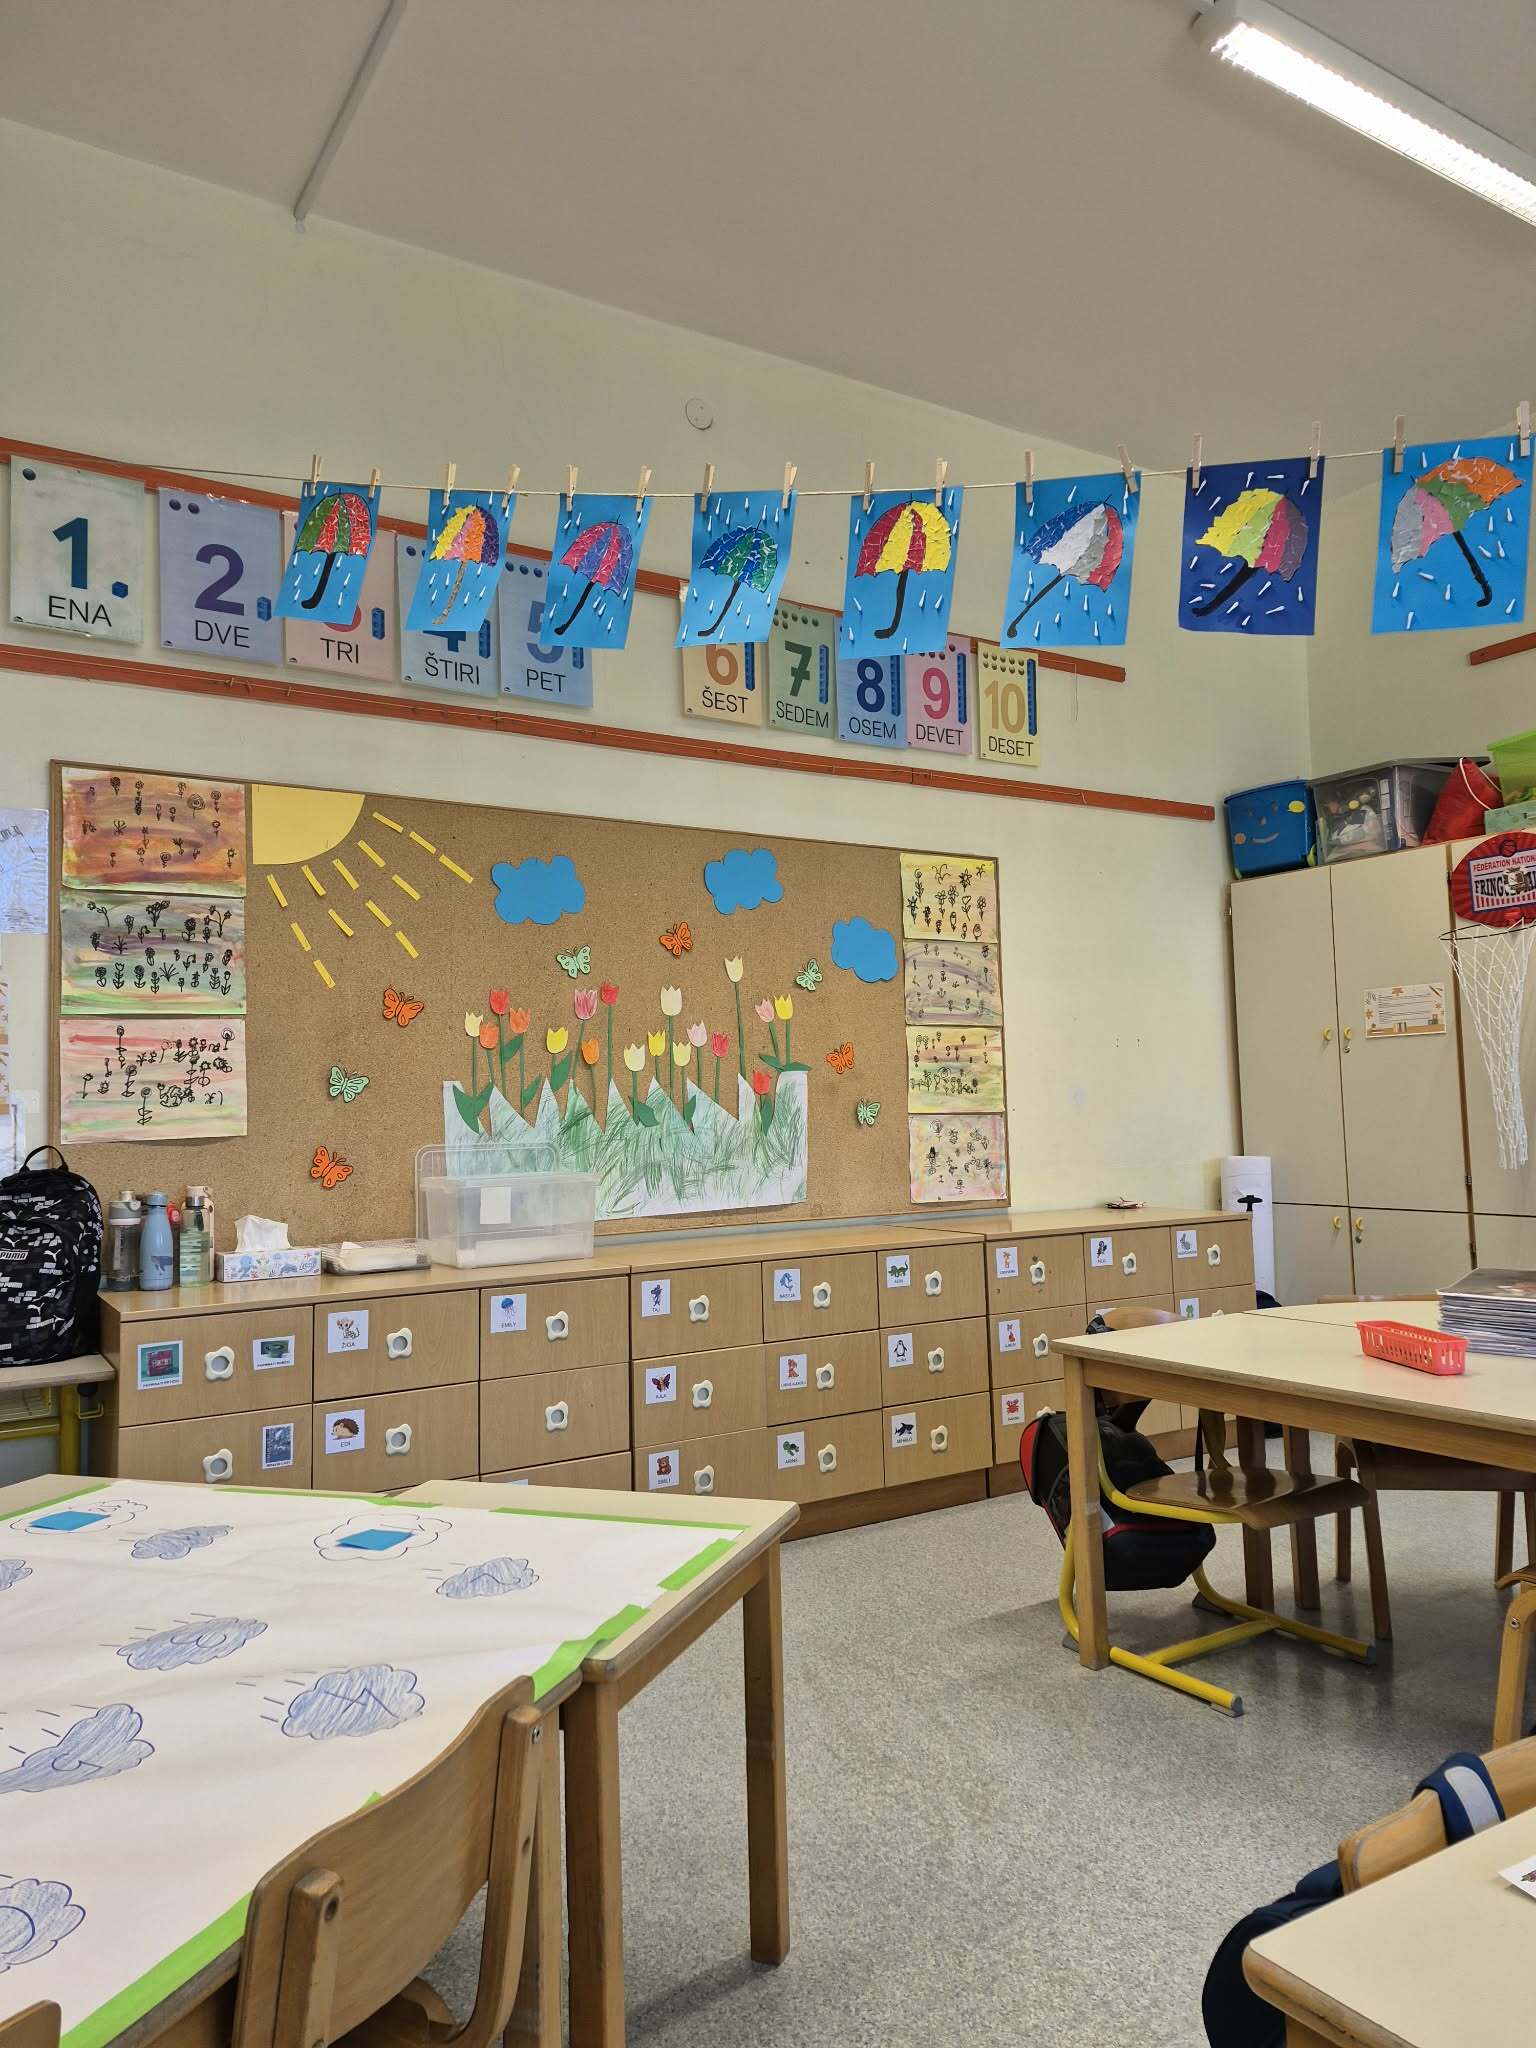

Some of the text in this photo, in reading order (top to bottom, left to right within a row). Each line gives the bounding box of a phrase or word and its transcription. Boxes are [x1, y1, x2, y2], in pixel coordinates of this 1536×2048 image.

[52, 517, 88, 589] 1
[195, 544, 244, 616] 2
[49, 595, 112, 627] ENA
[195, 620, 250, 648] DVE
[320, 637, 359, 664] TRI
[706, 644, 738, 685] 6
[425, 652, 479, 685] ŠTIRI
[526, 668, 567, 692] PET
[785, 640, 812, 696] 7
[702, 685, 749, 713] ŠEST
[857, 659, 885, 712] 8
[923, 667, 950, 719] 9
[776, 700, 829, 728] SEDEM
[984, 680, 1026, 734] 10
[849, 716, 897, 739] OSEM
[915, 723, 964, 745] DEVET
[988, 735, 1034, 756] DESET
[1473, 859, 1511, 872] FEDERATION
